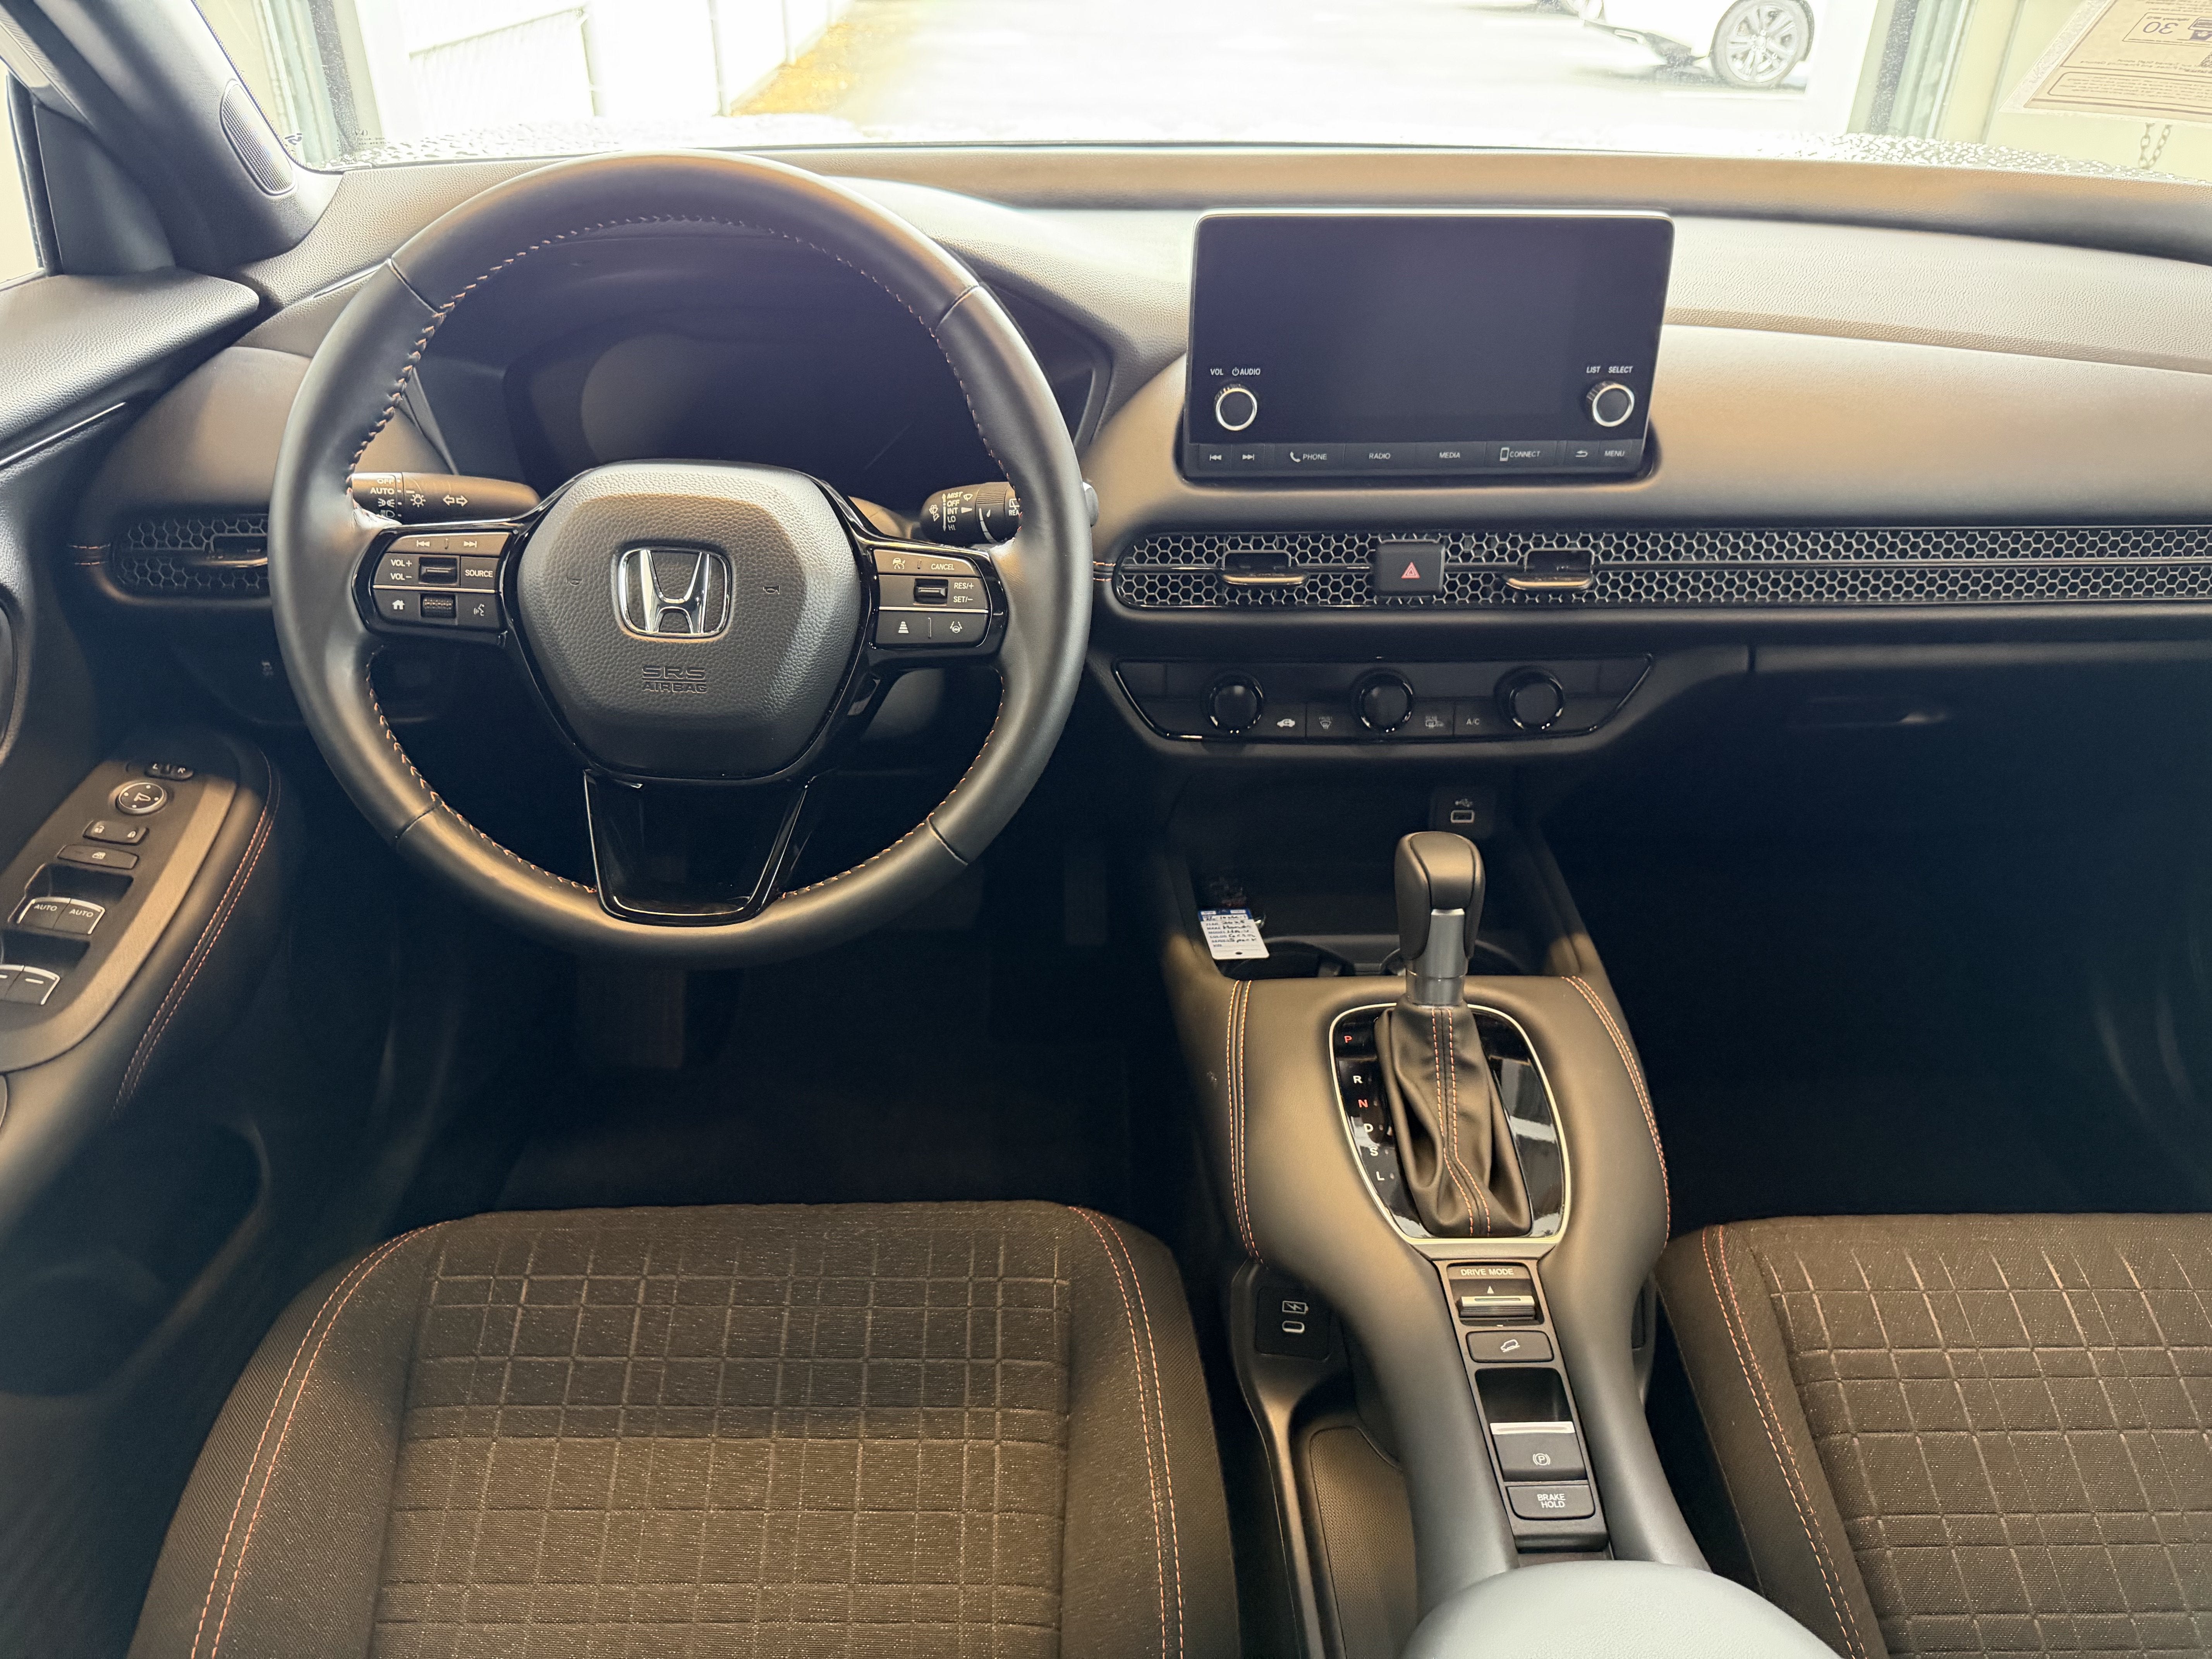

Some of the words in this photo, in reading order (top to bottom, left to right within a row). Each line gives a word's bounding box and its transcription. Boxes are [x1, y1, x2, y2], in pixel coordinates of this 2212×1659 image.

[465, 569, 493, 578] SOURCE
[642, 665, 706, 680] SRS
[642, 682, 708, 694] AIRBAG
[69, 908, 94, 918] AUTO
[1344, 1035, 1353, 1043] P
[1353, 1075, 1363, 1084] R
[1358, 1099, 1368, 1108] N
[1364, 1123, 1374, 1133] D
[1369, 1147, 1379, 1156] S
[1376, 1171, 1385, 1181] L
[1537, 1493, 1566, 1501] BRAKE
[1541, 1500, 1565, 1508] HOLD
